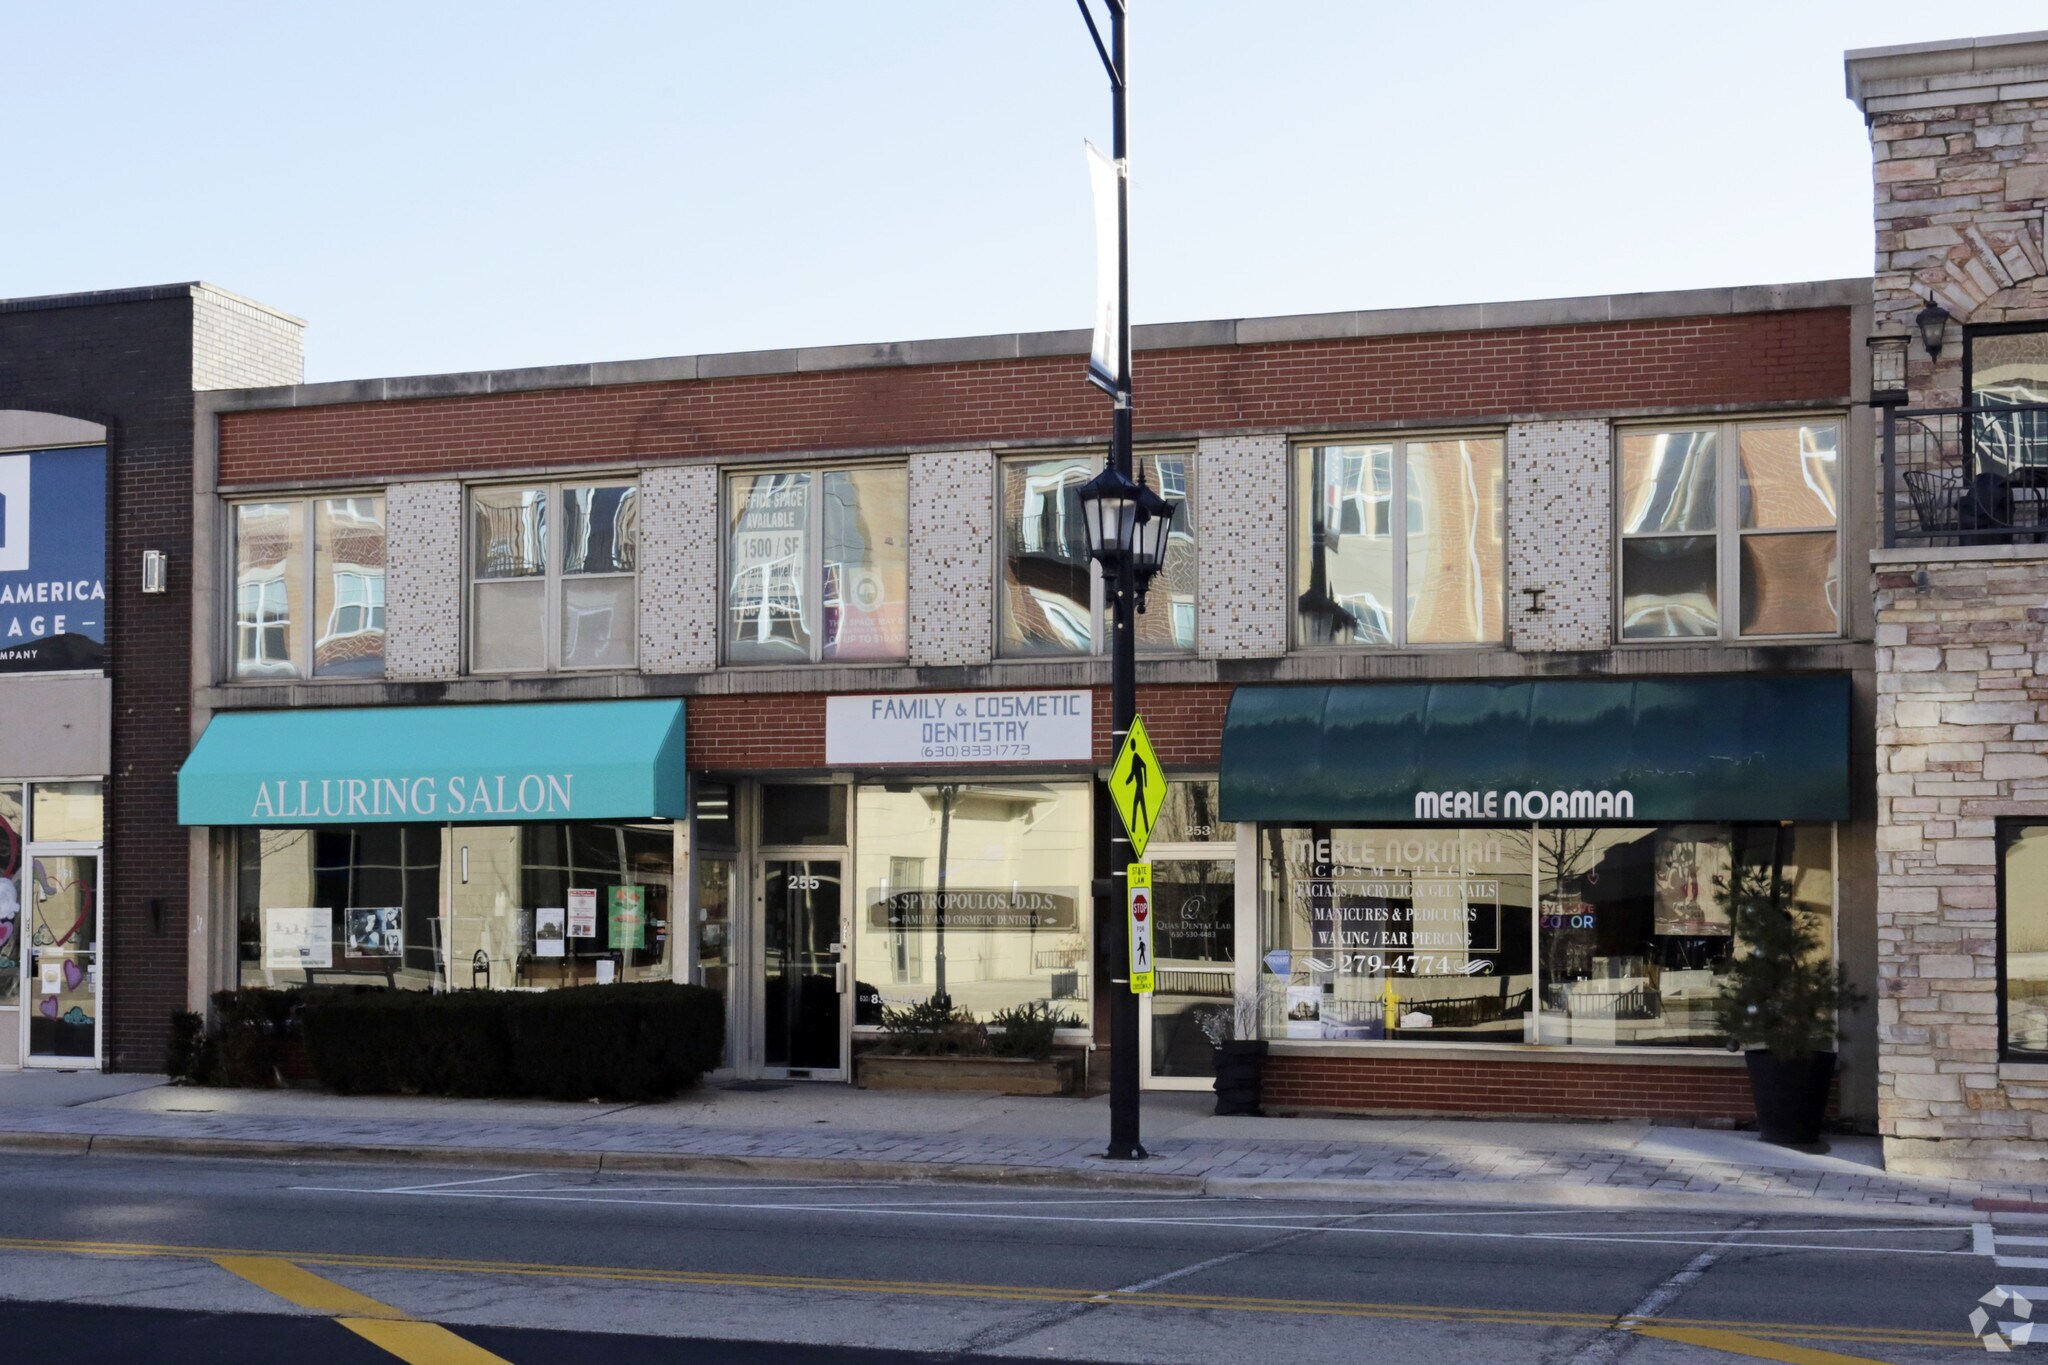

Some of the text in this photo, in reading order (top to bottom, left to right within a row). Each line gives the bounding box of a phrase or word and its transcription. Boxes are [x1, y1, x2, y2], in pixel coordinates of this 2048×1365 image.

[739, 491, 803, 509] OFFICE SPACE
[747, 512, 795, 528] AVAILABLE
[743, 538, 772, 558] 1500
[784, 537, 799, 556] SF
[0, 580, 105, 604] AMERICA
[872, 695, 1080, 719] FAMILY & COSMETIC
[922, 721, 1029, 743] DENTISTRY
[252, 774, 573, 817] ALLURING SALON
[1415, 790, 1634, 819] MERLE NORMAN
[1184, 825, 1211, 836] 253
[1291, 839, 1501, 863] MERLE NORMAN
[1132, 866, 1147, 875] STATE
[788, 875, 820, 889] 255
[1297, 885, 1347, 897] FACIALS
[1360, 884, 1412, 897] ACRYLIC
[1415, 885, 1425, 897] &
[1429, 885, 1455, 897] GEL
[1459, 884, 1495, 897] NAILS
[1016, 894, 1057, 910] D.D.S.
[1133, 903, 1148, 913] STOP
[1541, 904, 1561, 913] EYE
[901, 914, 1042, 925] FAMILY AND COSMETIC DENTISTRY
[1315, 908, 1477, 922] MANICURES & PEDICURES
[1318, 932, 1369, 945] WAXING
[1382, 932, 1408, 945] EAR
[1411, 932, 1473, 945] PIERCING
[1339, 955, 1449, 974] 279-4774
